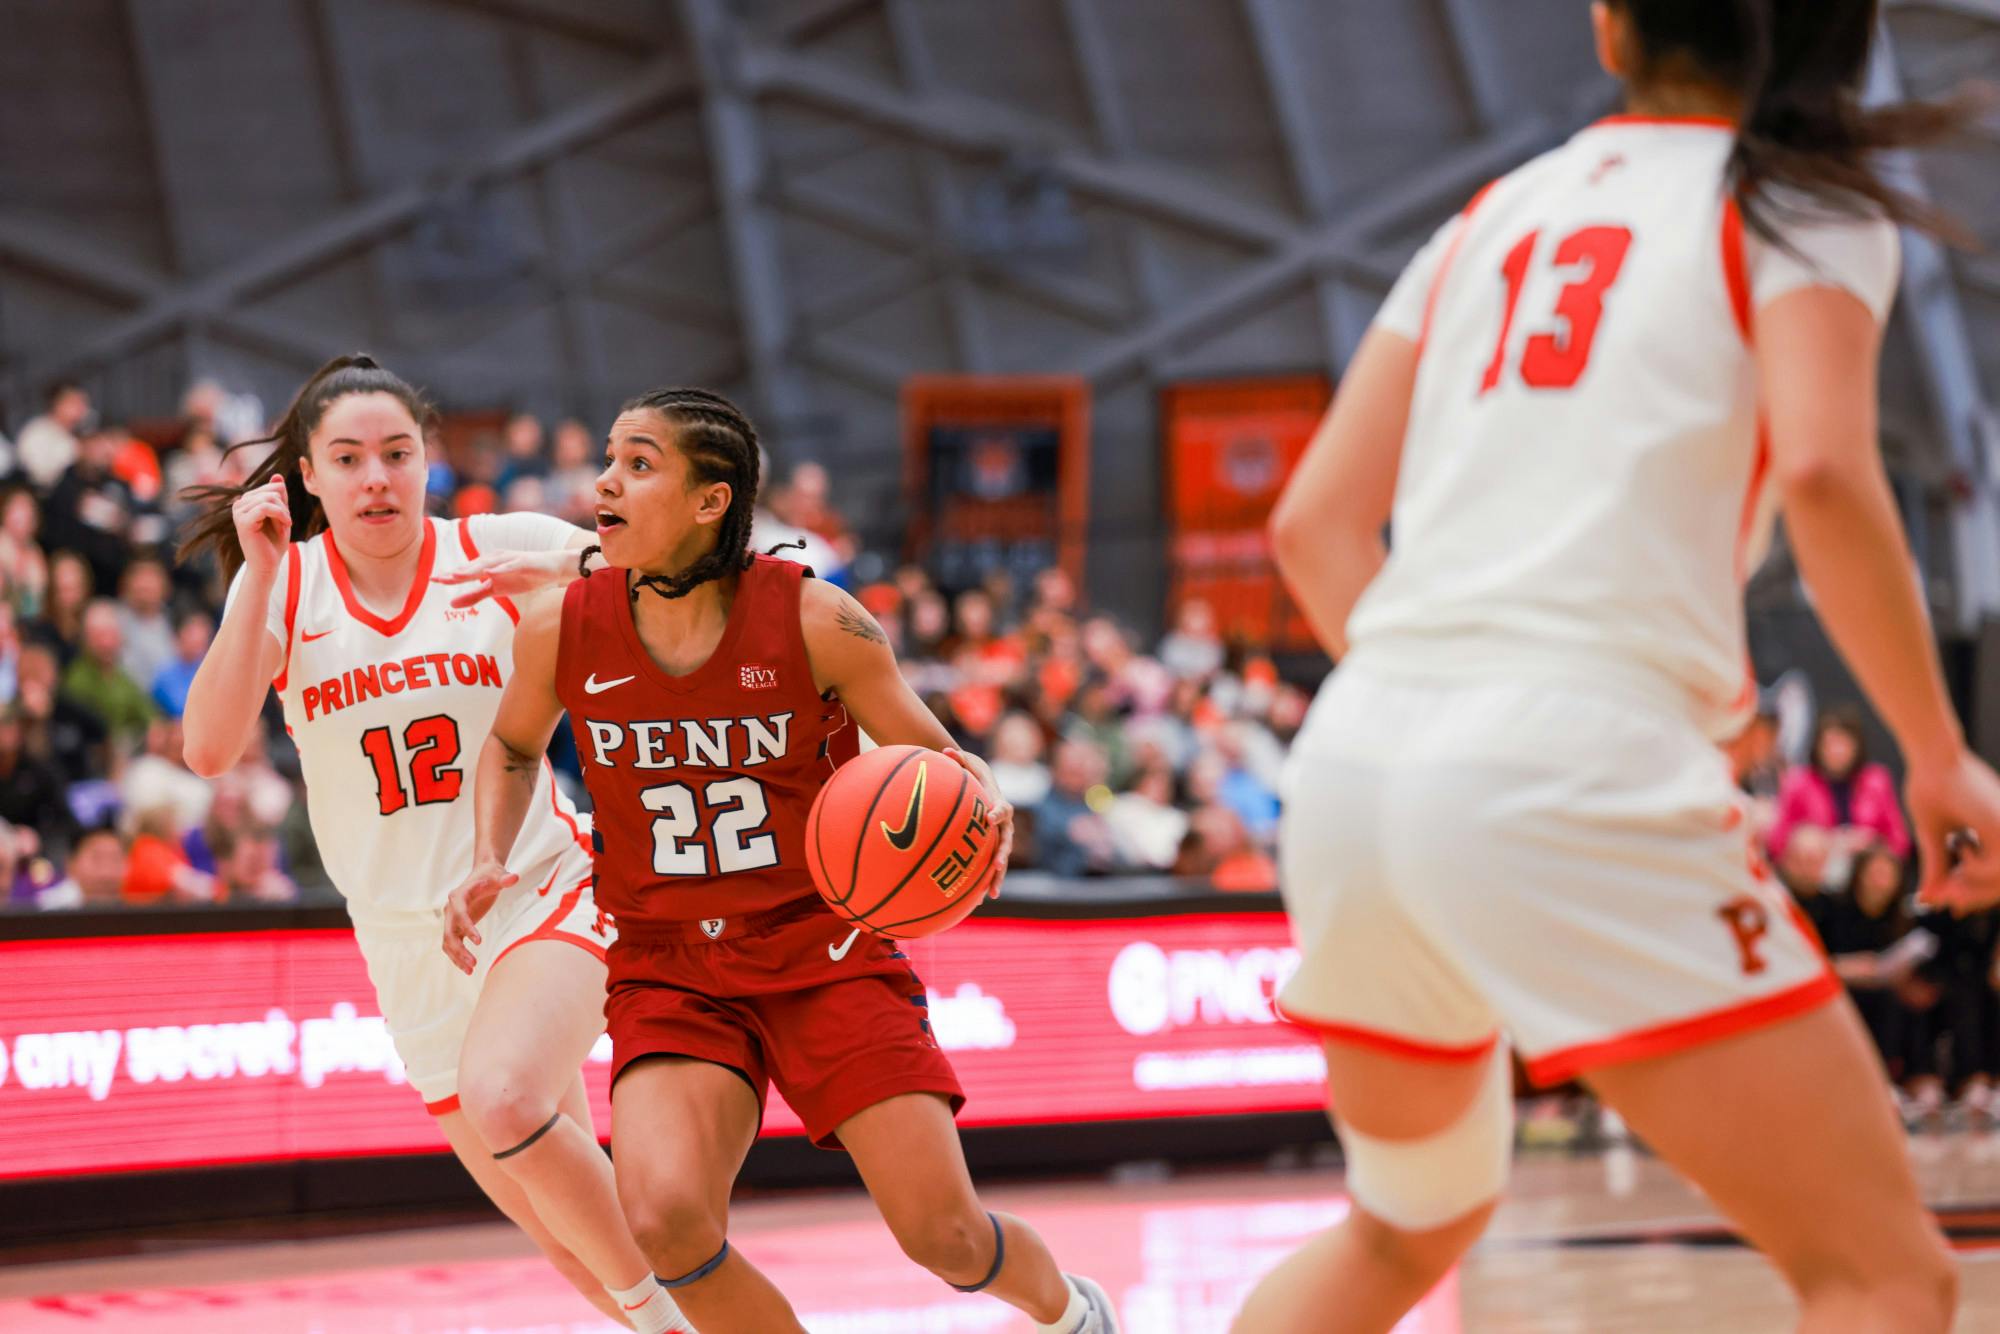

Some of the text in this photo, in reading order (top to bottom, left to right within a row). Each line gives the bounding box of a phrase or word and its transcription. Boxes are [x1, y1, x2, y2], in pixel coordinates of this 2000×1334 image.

[1477, 225, 1635, 398] 13
[302, 653, 503, 722] PRINCETON
[750, 669, 776, 683] IVY
[360, 713, 464, 816] 12
[584, 711, 794, 771] PENN
[639, 774, 782, 877] 22
[708, 920, 719, 933] P
[1716, 895, 1769, 977] P
[13, 1029, 122, 1100] any
